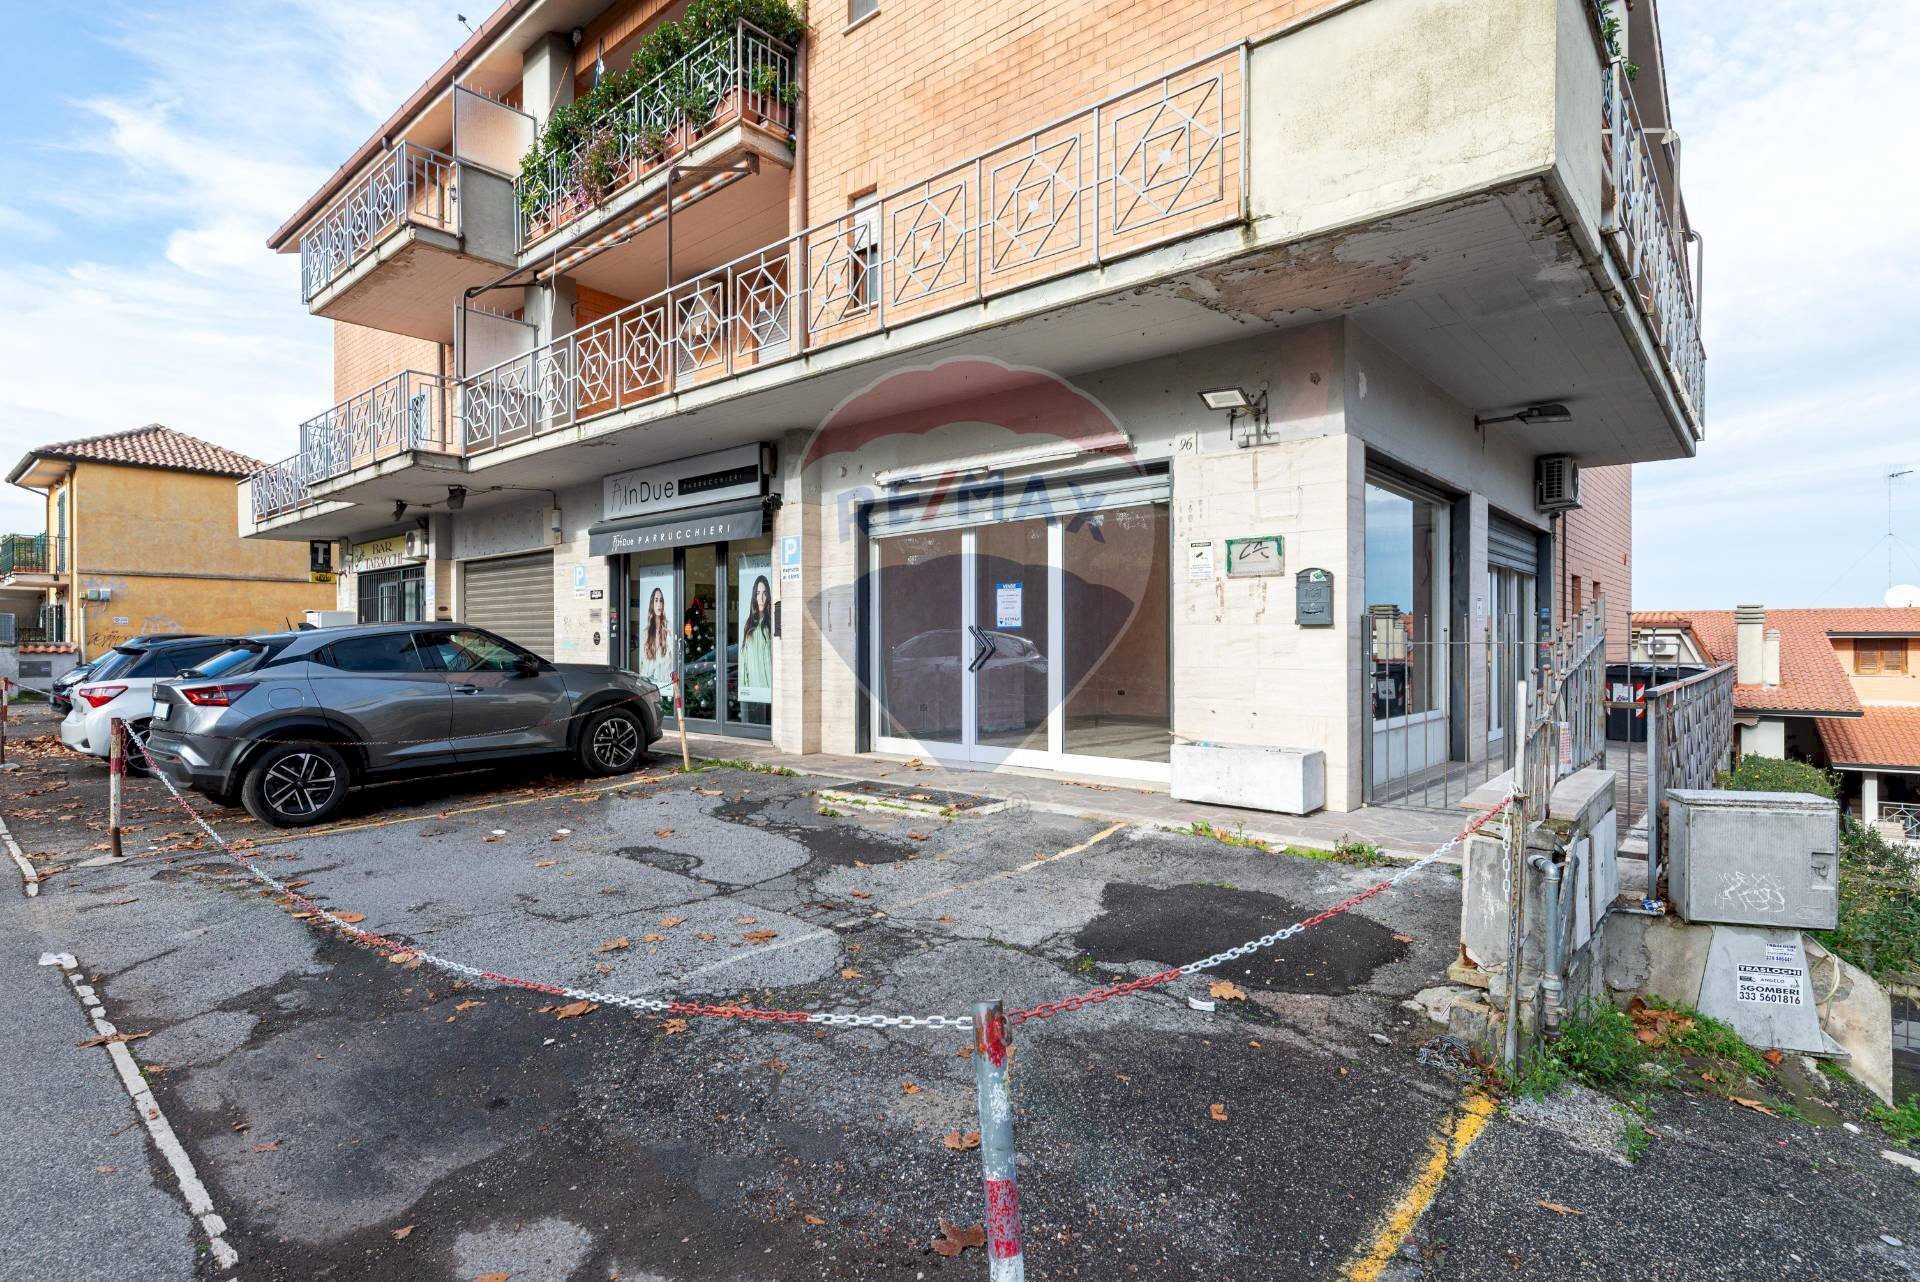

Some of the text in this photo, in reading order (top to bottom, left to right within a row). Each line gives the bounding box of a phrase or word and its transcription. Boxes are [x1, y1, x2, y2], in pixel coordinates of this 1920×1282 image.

[1179, 437, 1193, 451] 96
[638, 524, 730, 544] PARRUCCHIERI
[372, 541, 393, 555] BAR
[785, 538, 797, 564] P
[365, 552, 403, 570] TABACCHI
[1739, 965, 1801, 976] TRASLOCHI
[1740, 985, 1799, 995] SGOMBERI
[1739, 992, 1801, 1004] 333 5601816
